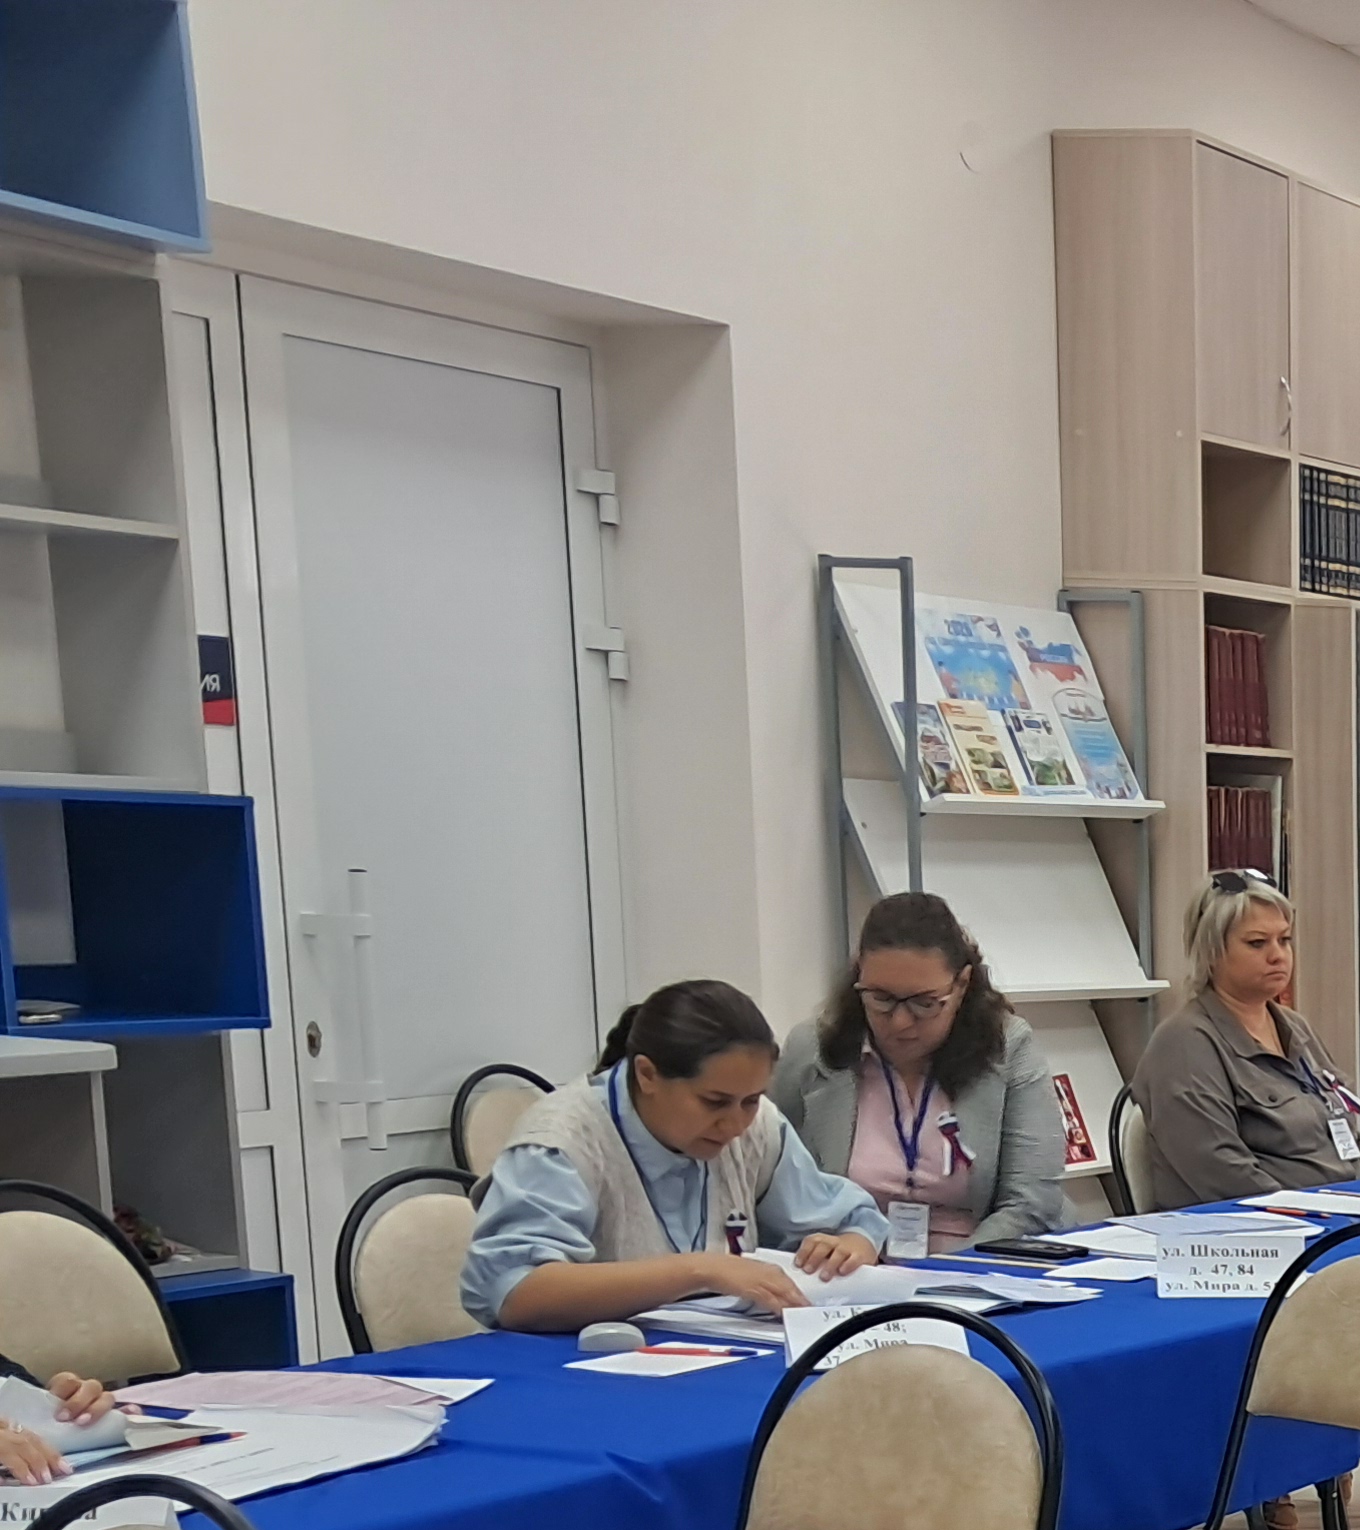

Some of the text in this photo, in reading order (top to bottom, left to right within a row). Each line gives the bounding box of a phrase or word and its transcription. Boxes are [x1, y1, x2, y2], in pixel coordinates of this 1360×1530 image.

[1162, 1244, 1280, 1260] ул. Школьная
[1237, 1264, 1255, 1275] 84
[1165, 1282, 1188, 1292] ул.
[1194, 1280, 1241, 1293] Мира
